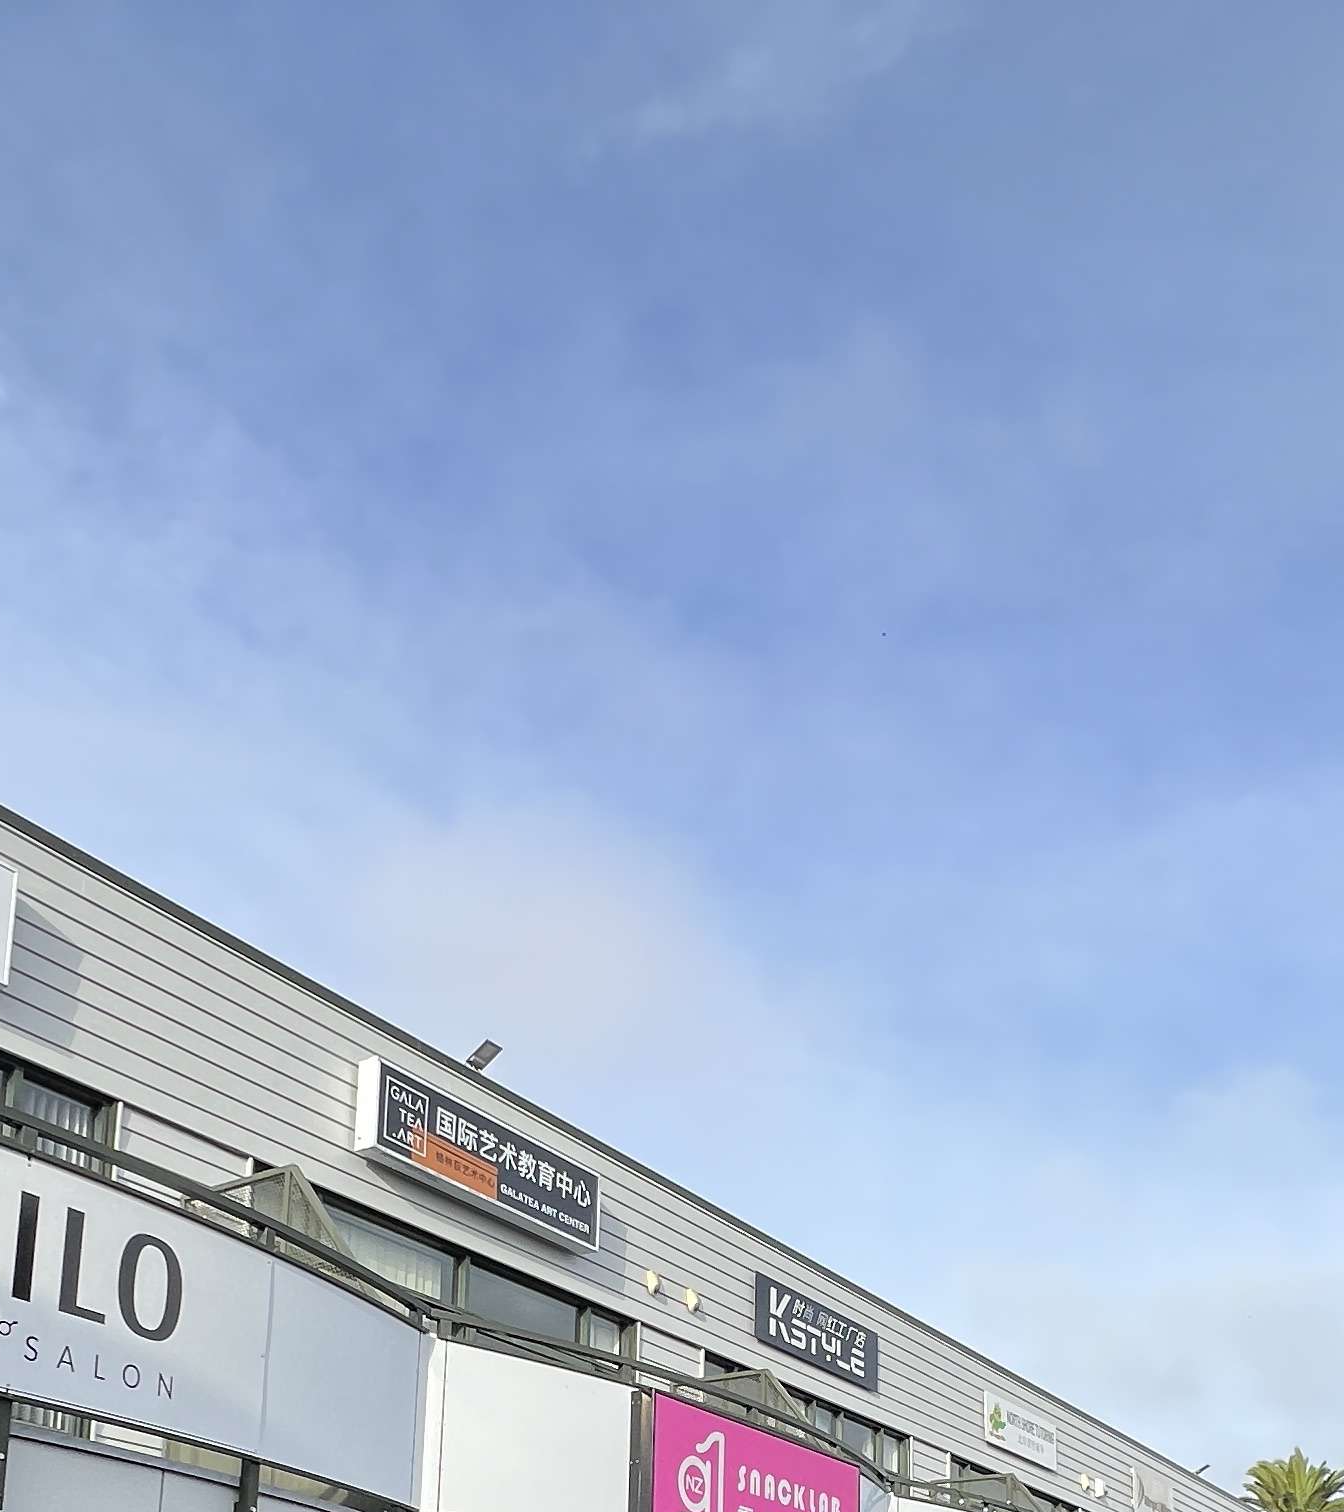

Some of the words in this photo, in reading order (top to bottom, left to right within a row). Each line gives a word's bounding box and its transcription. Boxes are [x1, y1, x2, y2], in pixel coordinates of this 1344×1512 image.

[390, 1085, 425, 1115] GALA
[399, 1107, 424, 1132] TEA
[435, 1106, 592, 1209] 国际艺术教育中心
[500, 1183, 539, 1212] GALATEA
[541, 1203, 558, 1220] ART
[558, 1212, 591, 1235] CENTER
[24, 1336, 174, 1401] SALON
